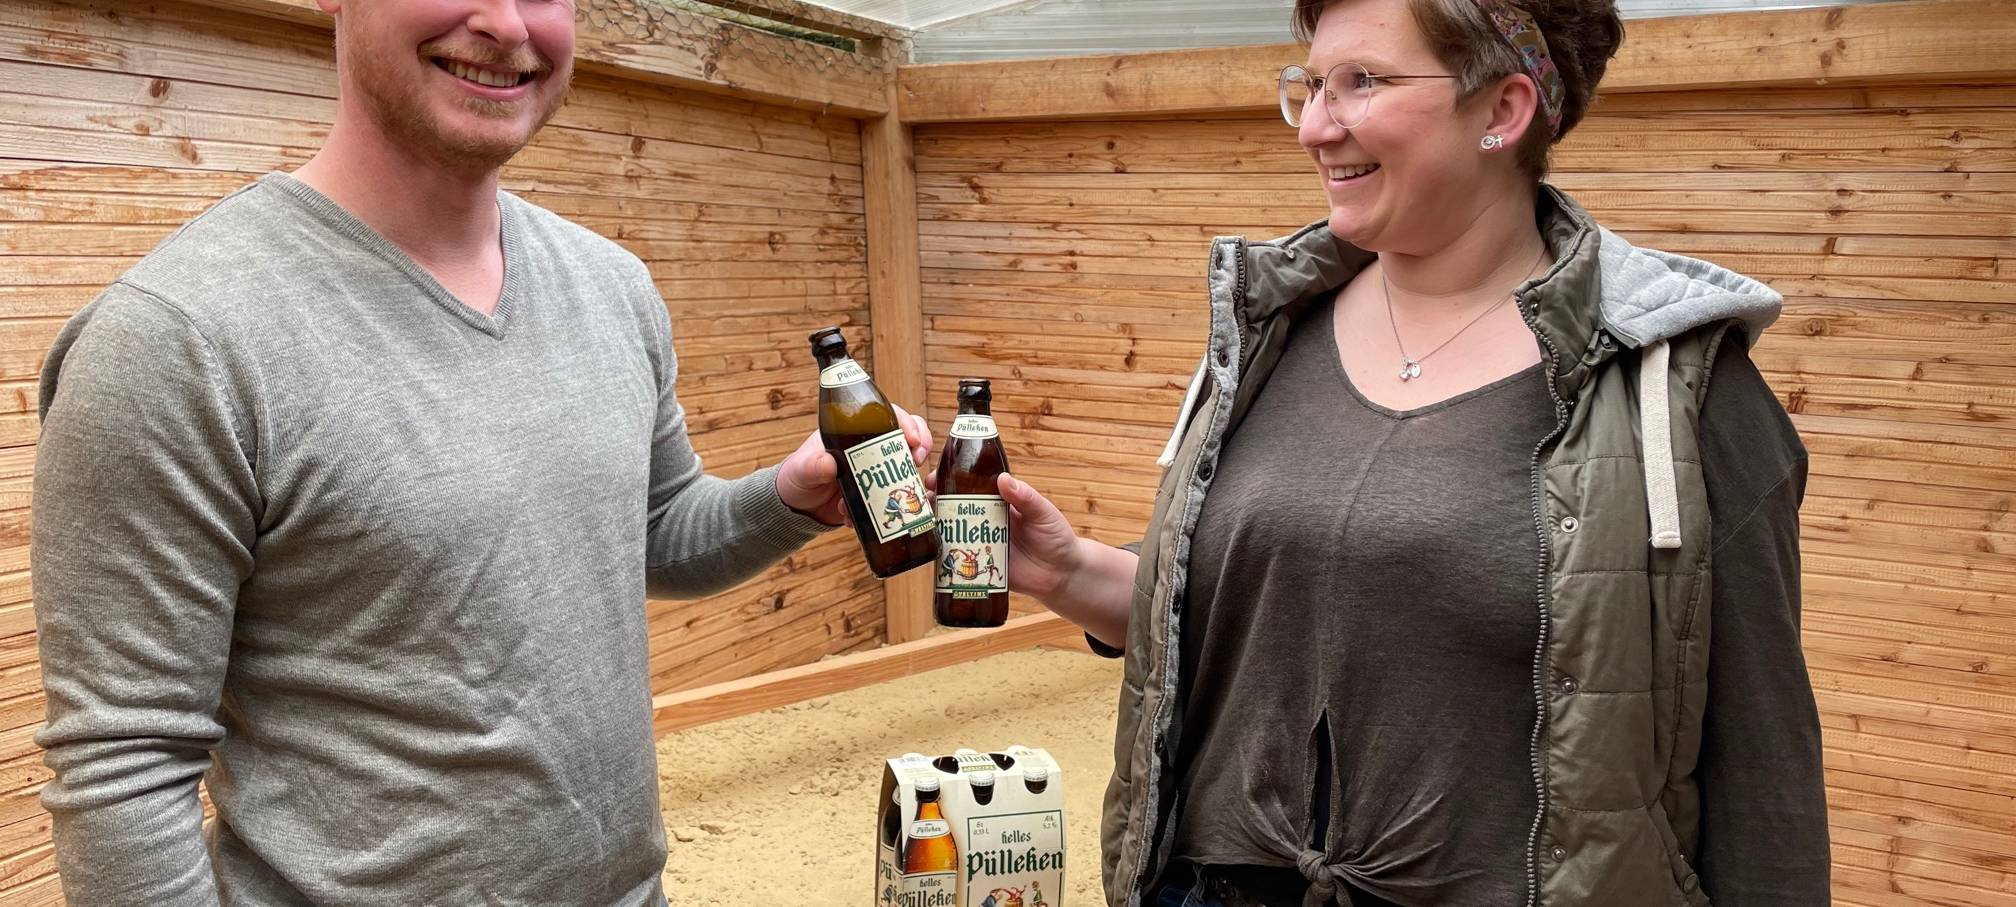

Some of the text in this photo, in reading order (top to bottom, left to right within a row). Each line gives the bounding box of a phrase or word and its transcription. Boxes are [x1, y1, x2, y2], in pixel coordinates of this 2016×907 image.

[880, 441, 904, 457] helles
[957, 503, 986, 515] helles
[1001, 830, 1031, 844] helles
[966, 847, 1064, 883] Pülleken
[920, 878, 941, 887] helles
